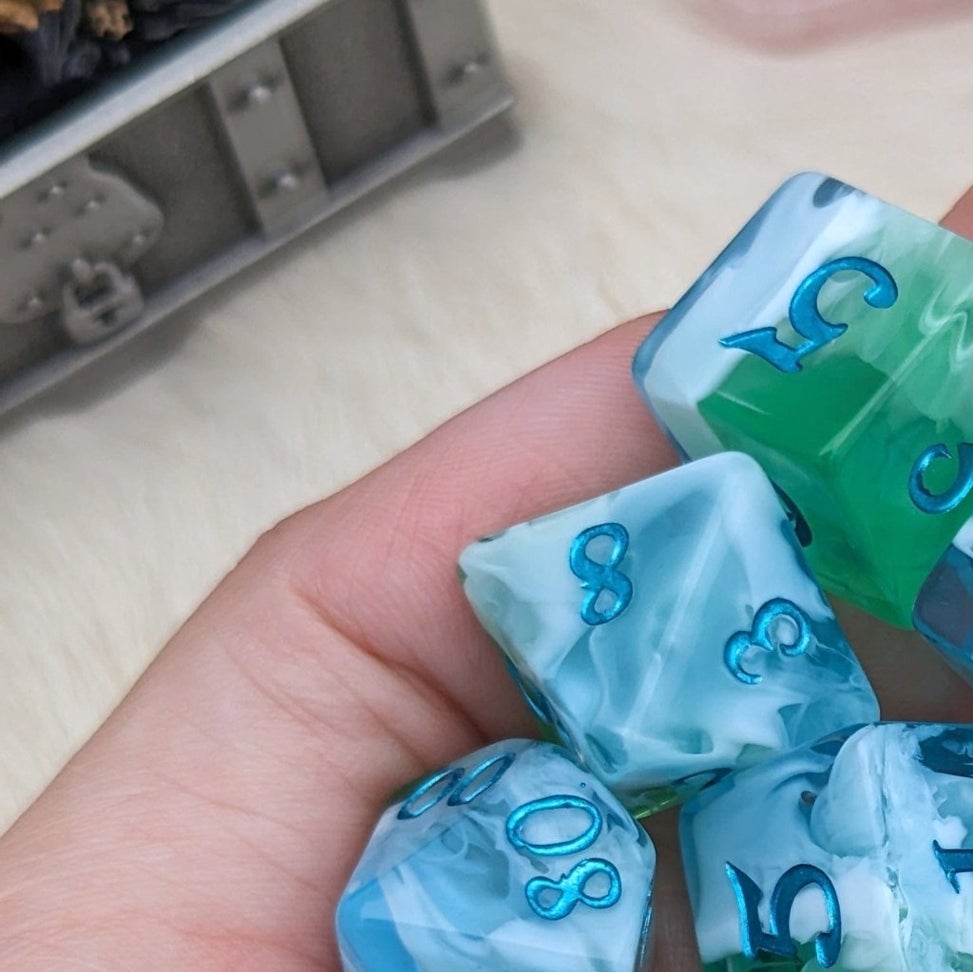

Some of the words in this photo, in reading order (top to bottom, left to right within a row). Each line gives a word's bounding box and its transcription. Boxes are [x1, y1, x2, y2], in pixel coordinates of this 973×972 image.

[717, 256, 898, 373] 5
[569, 522, 634, 626] 8
[723, 597, 810, 685] 3
[725, 860, 843, 969] 5
